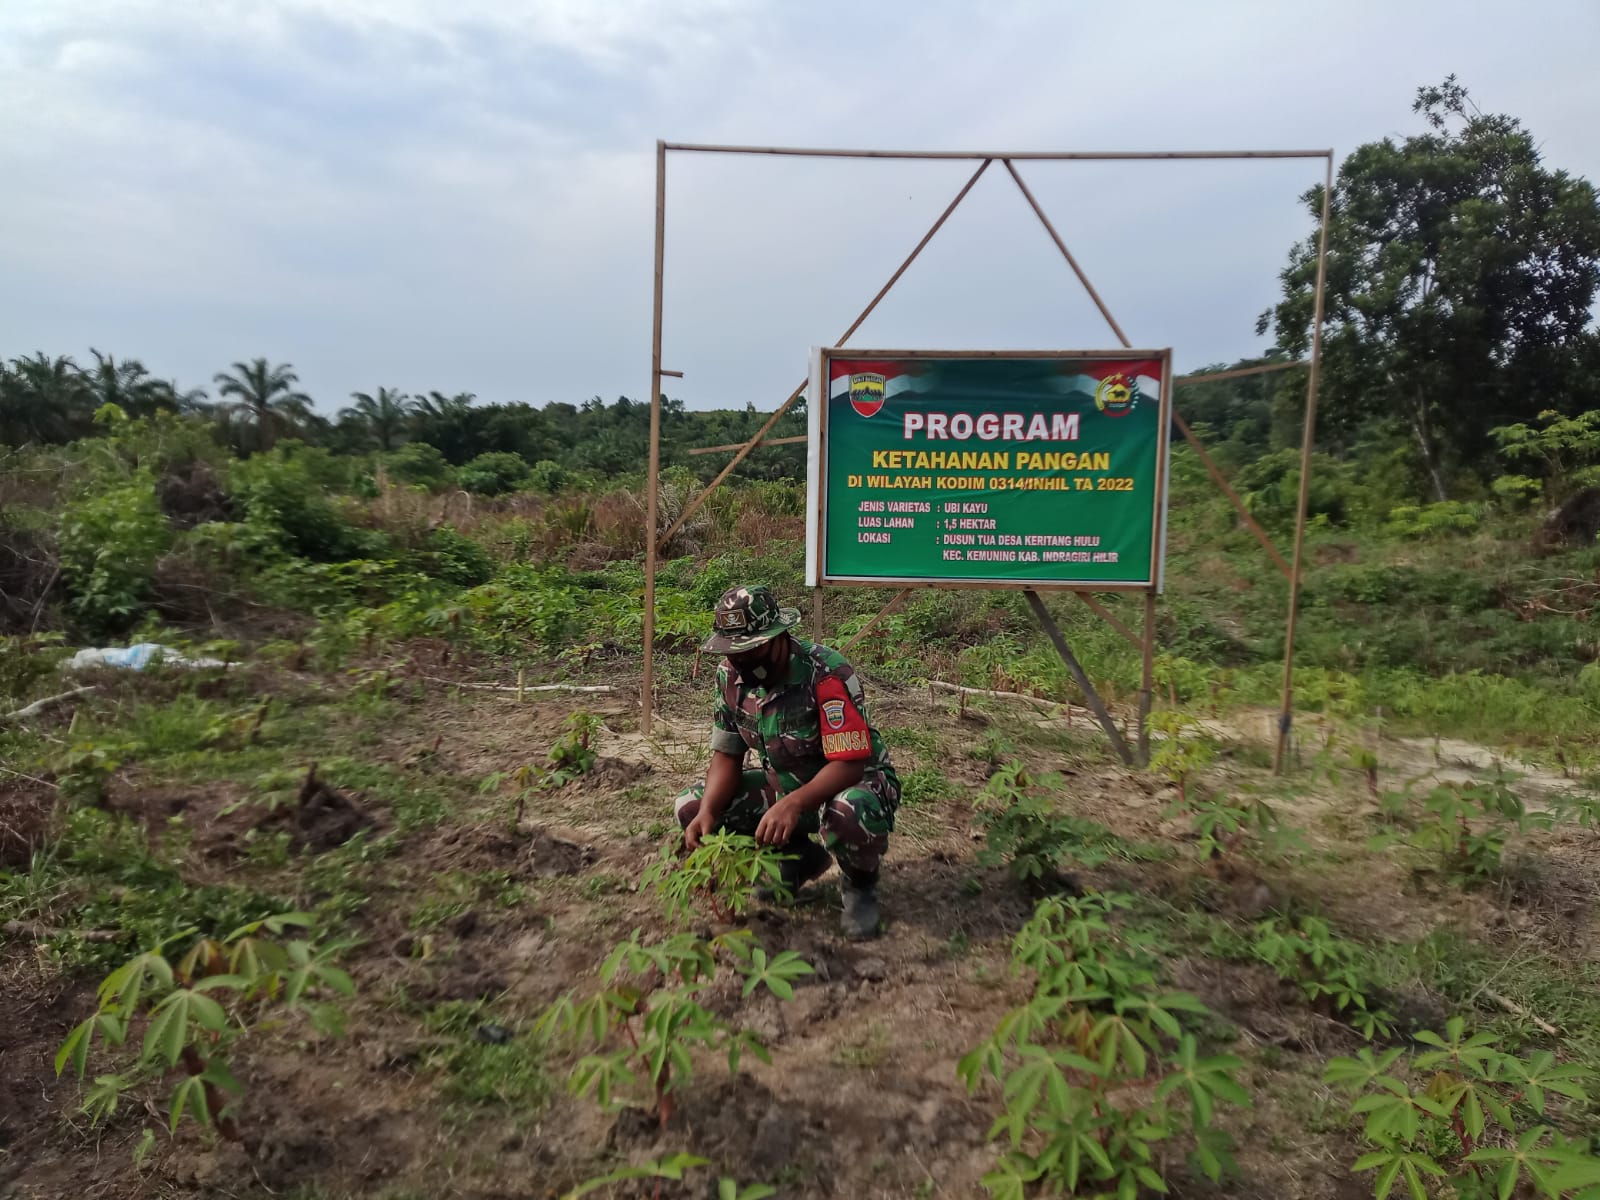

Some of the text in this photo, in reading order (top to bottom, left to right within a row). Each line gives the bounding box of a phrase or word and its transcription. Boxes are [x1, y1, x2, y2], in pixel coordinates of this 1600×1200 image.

[903, 412, 1080, 440] PROGRAM
[873, 450, 1110, 471] KETAHANAN PANGAN
[848, 475, 1134, 491] DI WILAYAH KODIM 0314/INHIL TA 2022
[858, 502, 885, 513] JENIS
[887, 502, 930, 513] VARIETAS
[944, 503, 960, 513] UBI
[963, 503, 988, 513] KAYU
[858, 517, 881, 528] LUAS
[884, 518, 914, 528] LAHAN
[944, 519, 957, 531] 1,5
[960, 519, 996, 530] HEKTAR
[858, 533, 891, 544] LOKASI
[943, 535, 975, 545] DUSUN
[978, 535, 996, 546] TUA
[998, 535, 1022, 546] DESA
[1024, 535, 1072, 546] KERITANG
[1074, 536, 1100, 546] HULU
[943, 550, 1118, 562] KEC. KEMUNING KAB. INDRAGIRI HILIR
